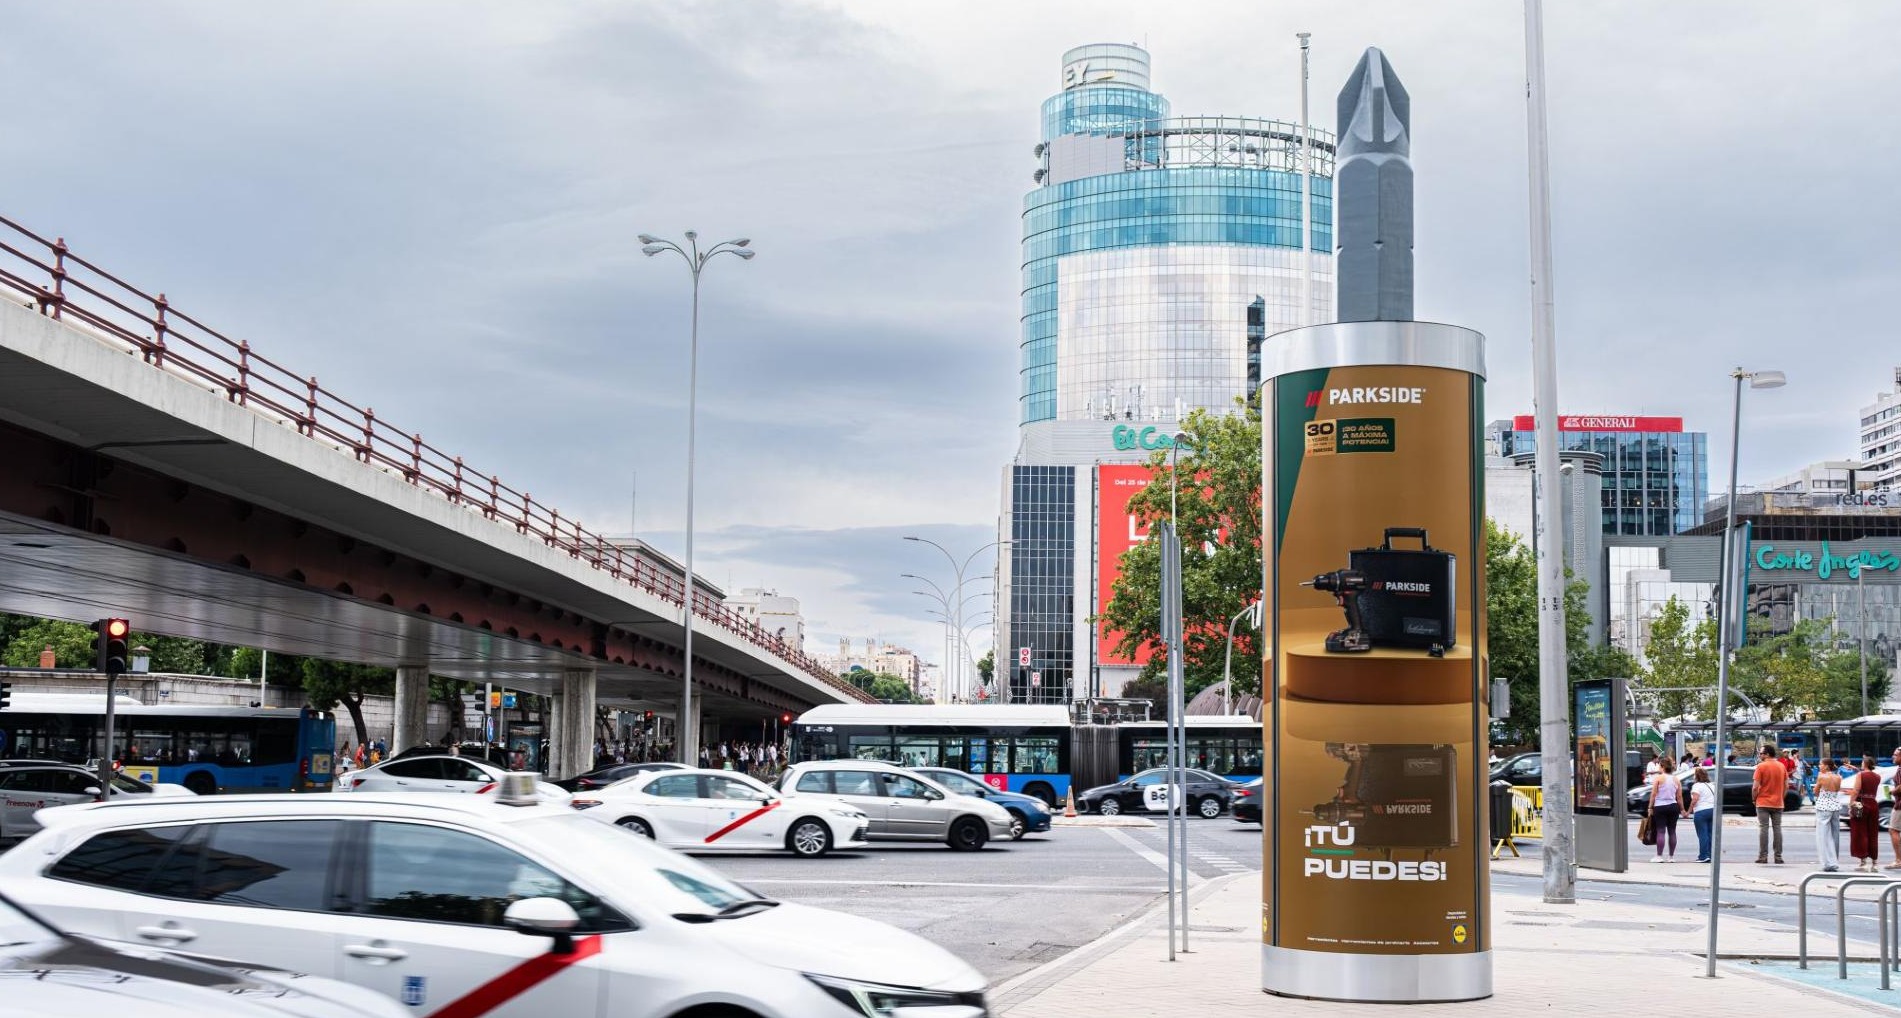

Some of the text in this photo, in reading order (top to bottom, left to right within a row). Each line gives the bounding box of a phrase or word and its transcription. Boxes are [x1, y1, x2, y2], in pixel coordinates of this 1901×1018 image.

[1329, 387, 1422, 405] PARKSIDE
[1307, 422, 1334, 436] 30
[1581, 418, 1636, 428] GENERALI
[1112, 425, 1136, 450] El
[1836, 490, 1888, 506] red.es
[1756, 545, 1813, 570] Corte
[1385, 581, 1431, 592] PARKSIDE
[1305, 820, 1355, 847] ¡TÚ
[1304, 858, 1447, 881] PUEDES!
